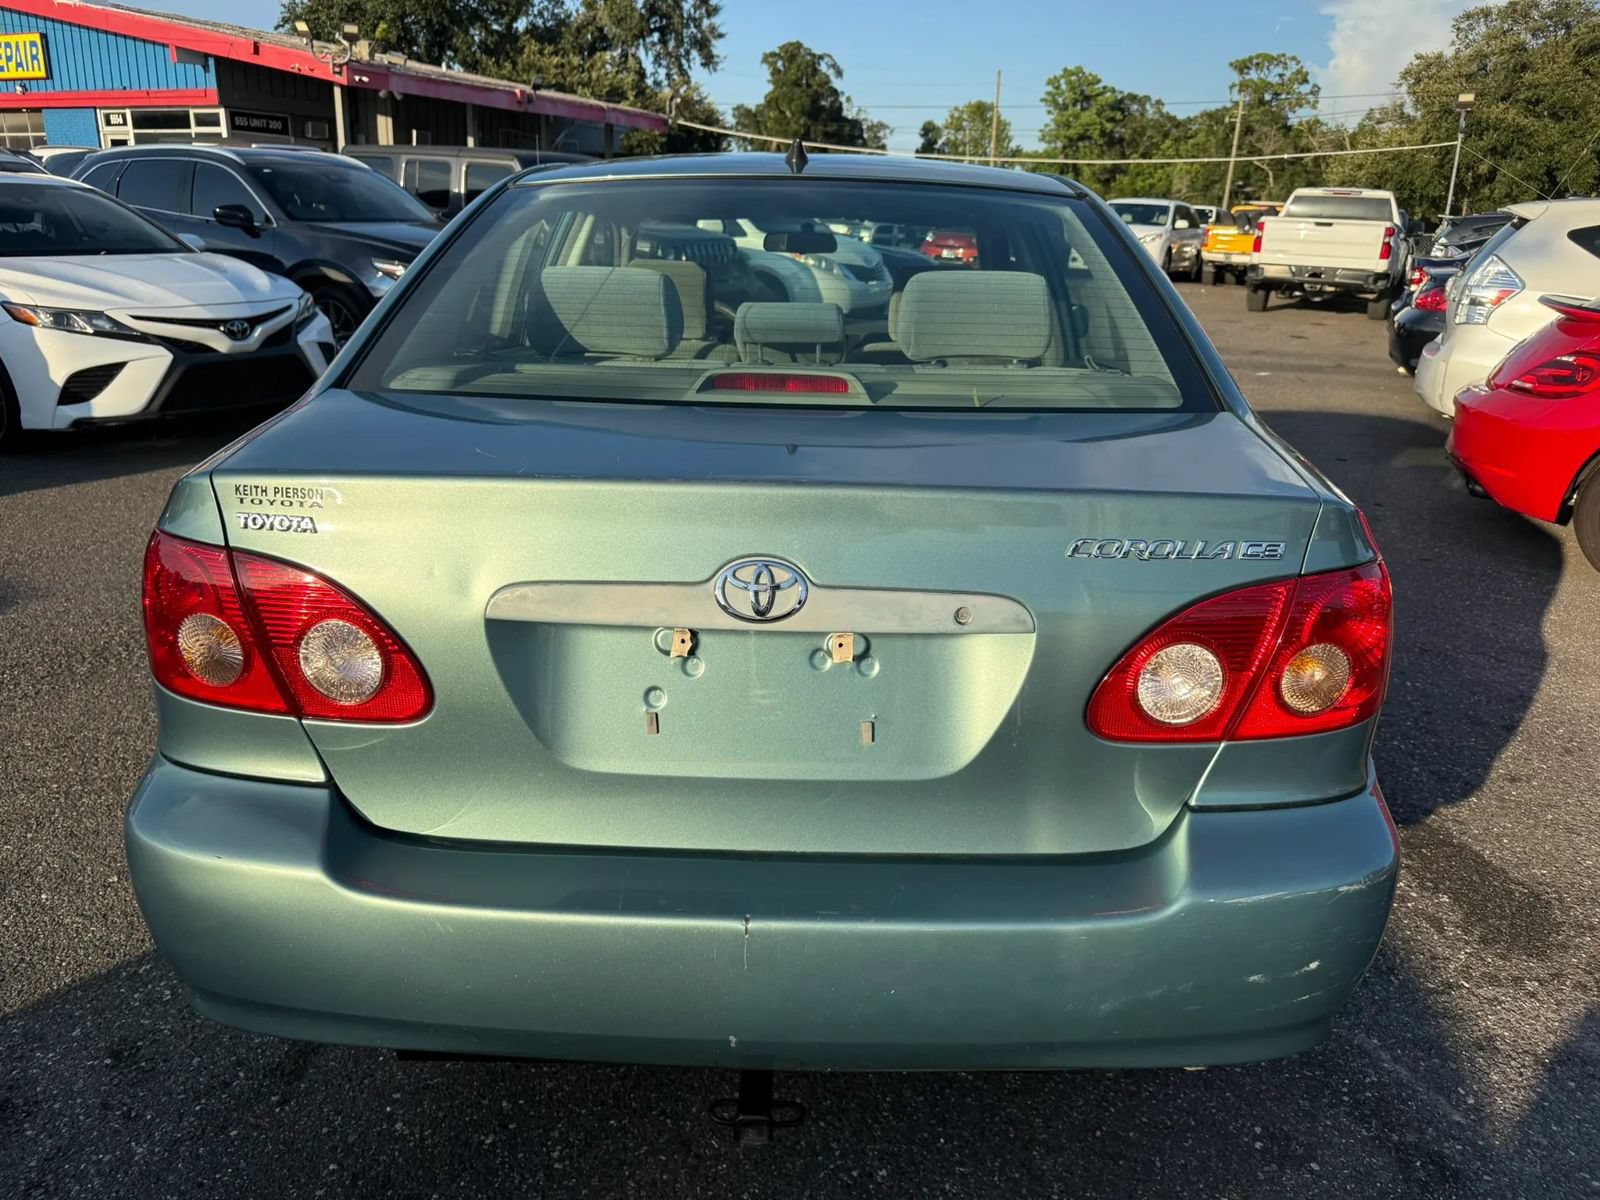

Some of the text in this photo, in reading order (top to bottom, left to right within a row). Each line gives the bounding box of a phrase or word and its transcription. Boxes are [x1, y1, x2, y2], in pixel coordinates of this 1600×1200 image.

[249, 117, 267, 128] UNIT
[234, 484, 324, 500] KEITH PIERSON
[236, 498, 324, 508] TOYOTA
[236, 512, 318, 533] TOYOTA
[1065, 538, 1236, 561] COROLLA
